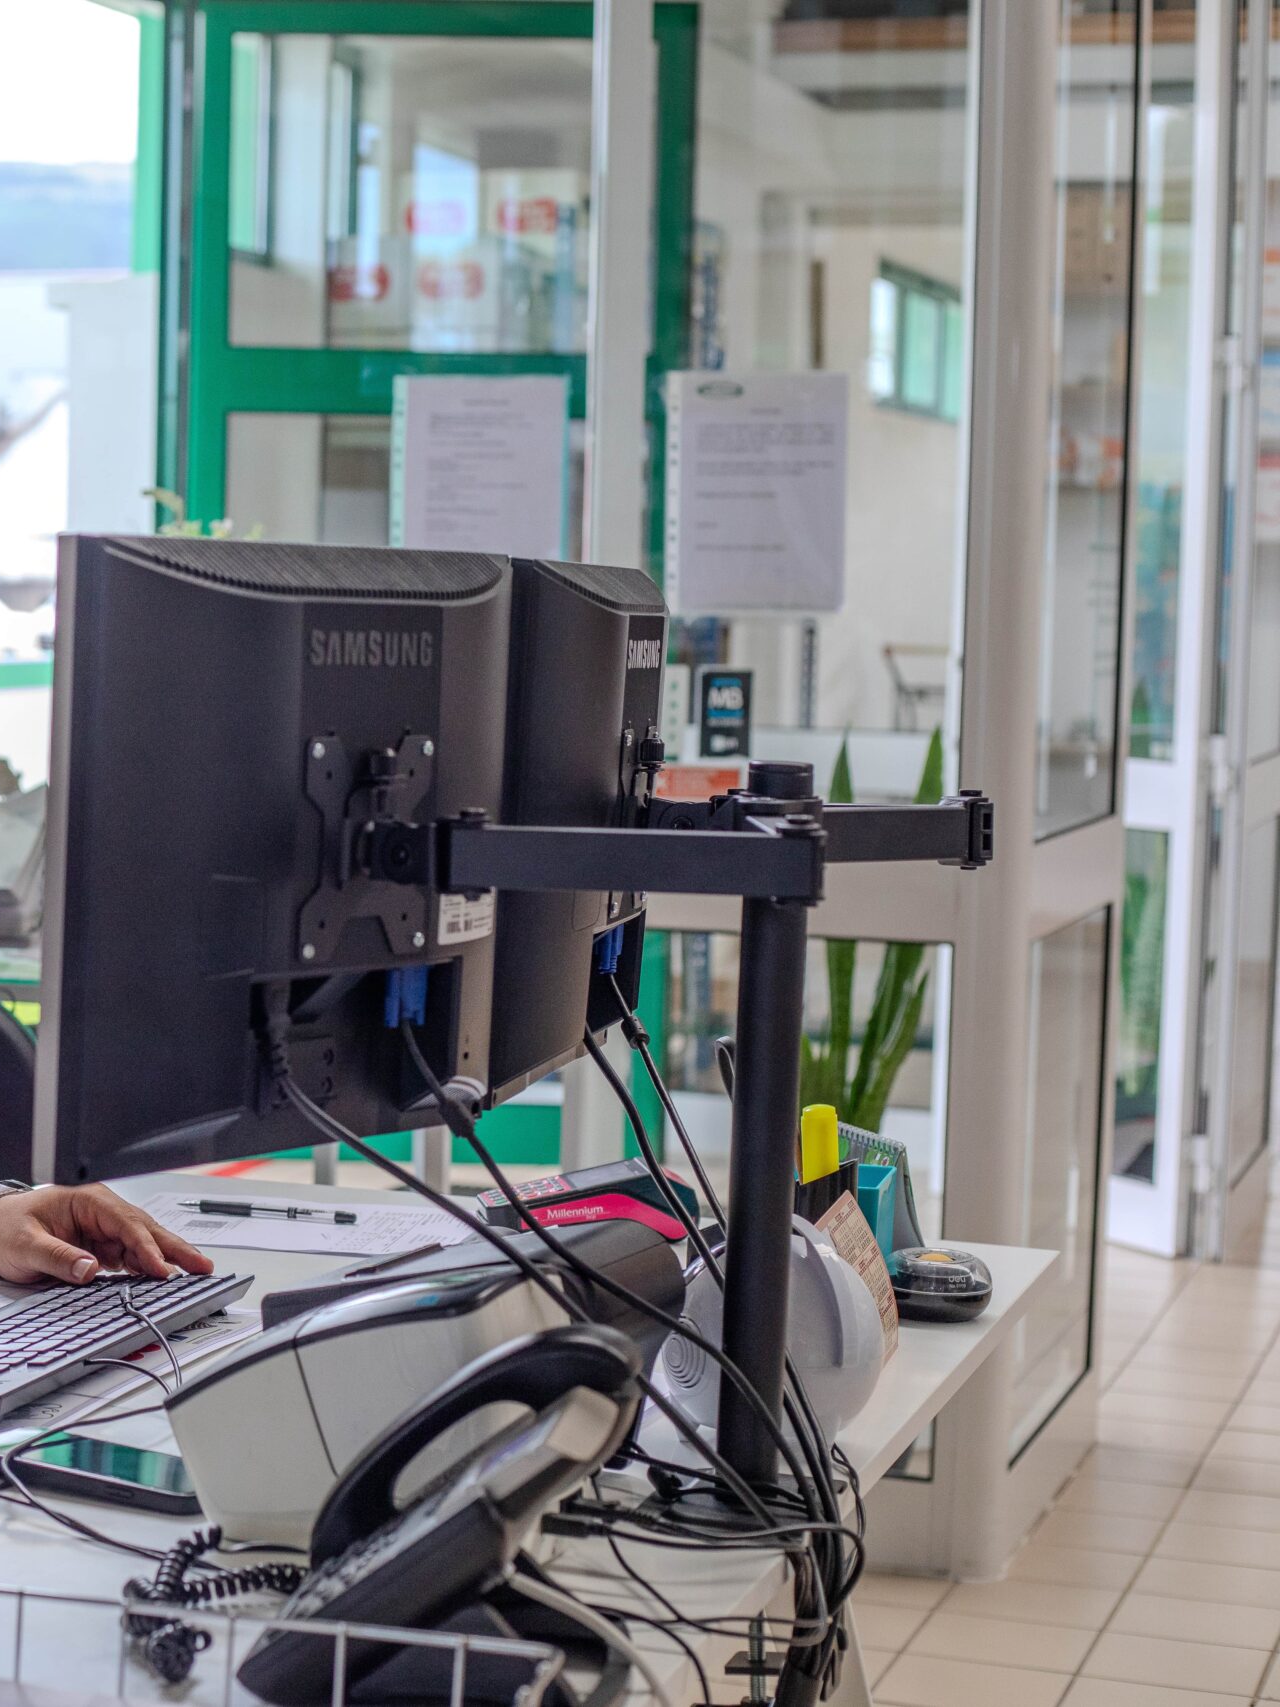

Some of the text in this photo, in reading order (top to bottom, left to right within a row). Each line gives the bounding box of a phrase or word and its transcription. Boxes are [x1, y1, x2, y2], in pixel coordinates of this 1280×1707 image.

[311, 629, 433, 667] SAMSUNG
[627, 639, 661, 670] SAMSUNG
[546, 1205, 605, 1220] Millennium
